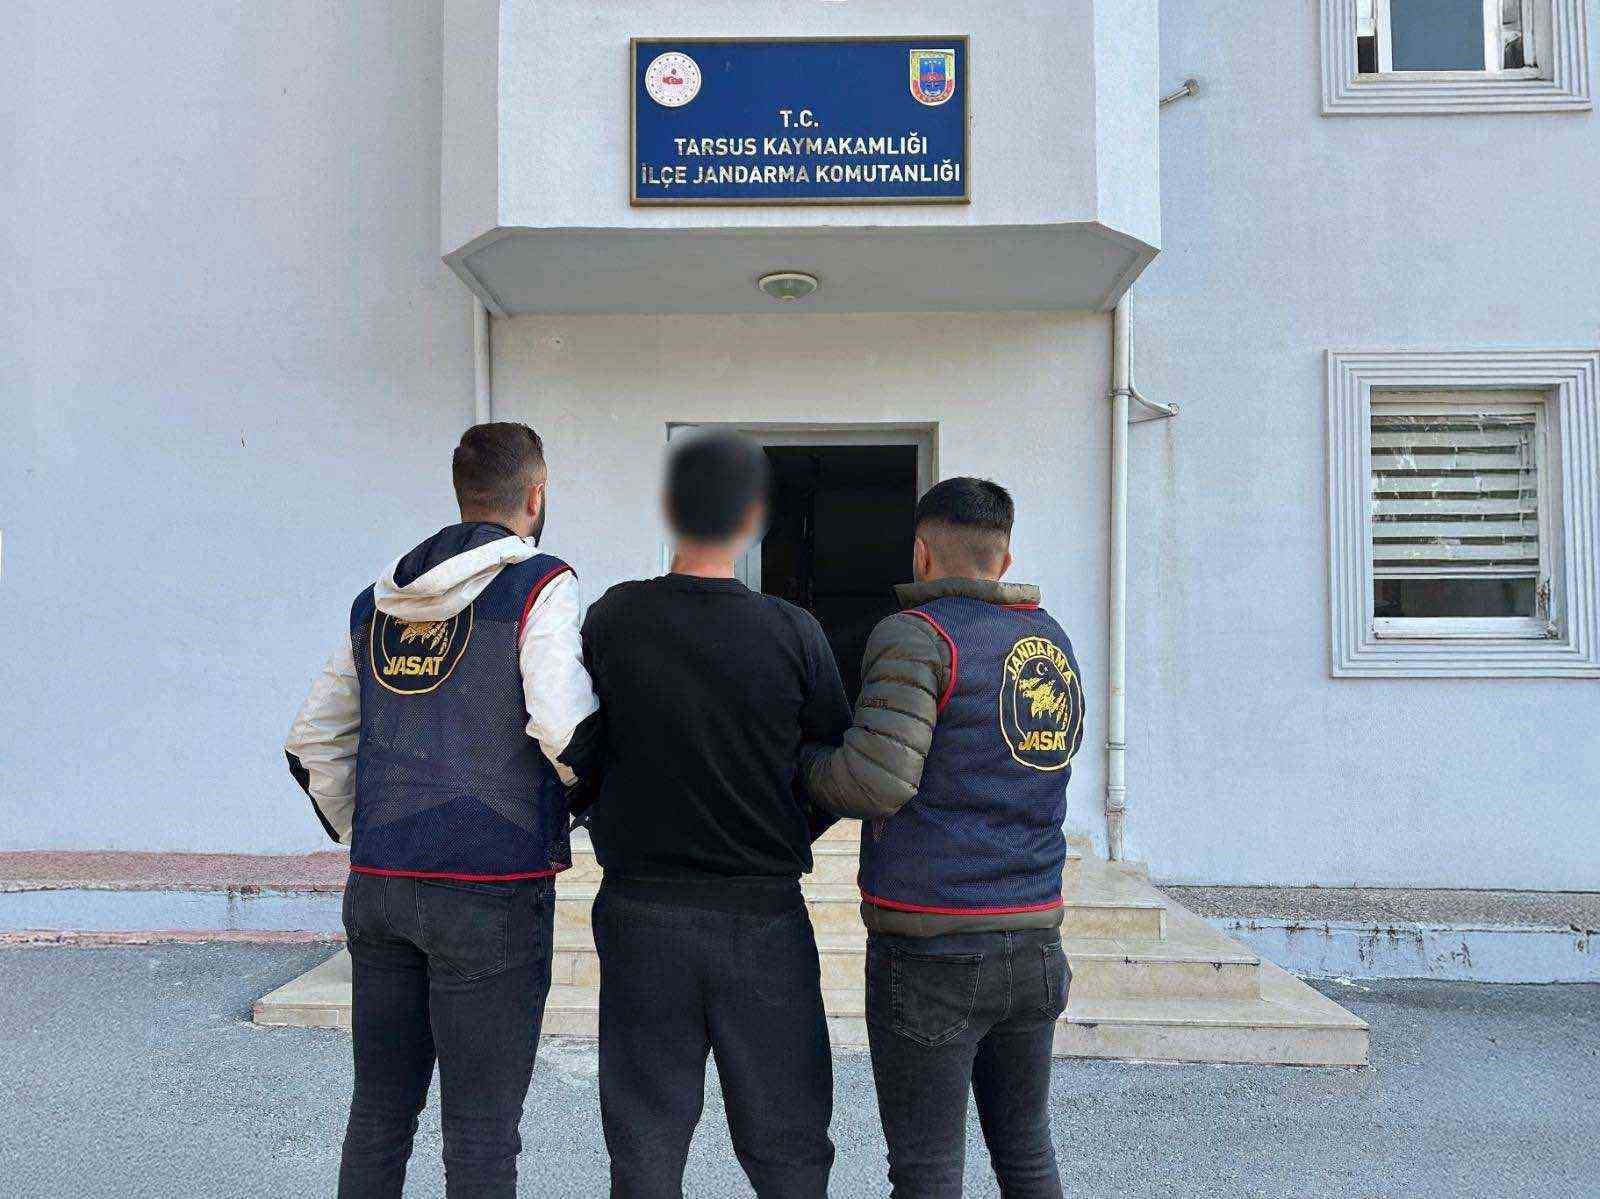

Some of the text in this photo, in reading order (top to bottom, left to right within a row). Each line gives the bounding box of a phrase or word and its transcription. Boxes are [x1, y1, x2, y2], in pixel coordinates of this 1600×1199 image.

[779, 109, 820, 128] T.C.
[673, 131, 928, 156] TARSUS KAYMAKAMLIĞI
[641, 159, 961, 189] İLÇE JANDARMA KOMUTANLIĞI
[383, 656, 444, 676] JASAT
[1006, 640, 1076, 683] JANDARMA
[1018, 730, 1067, 751] JASAT
